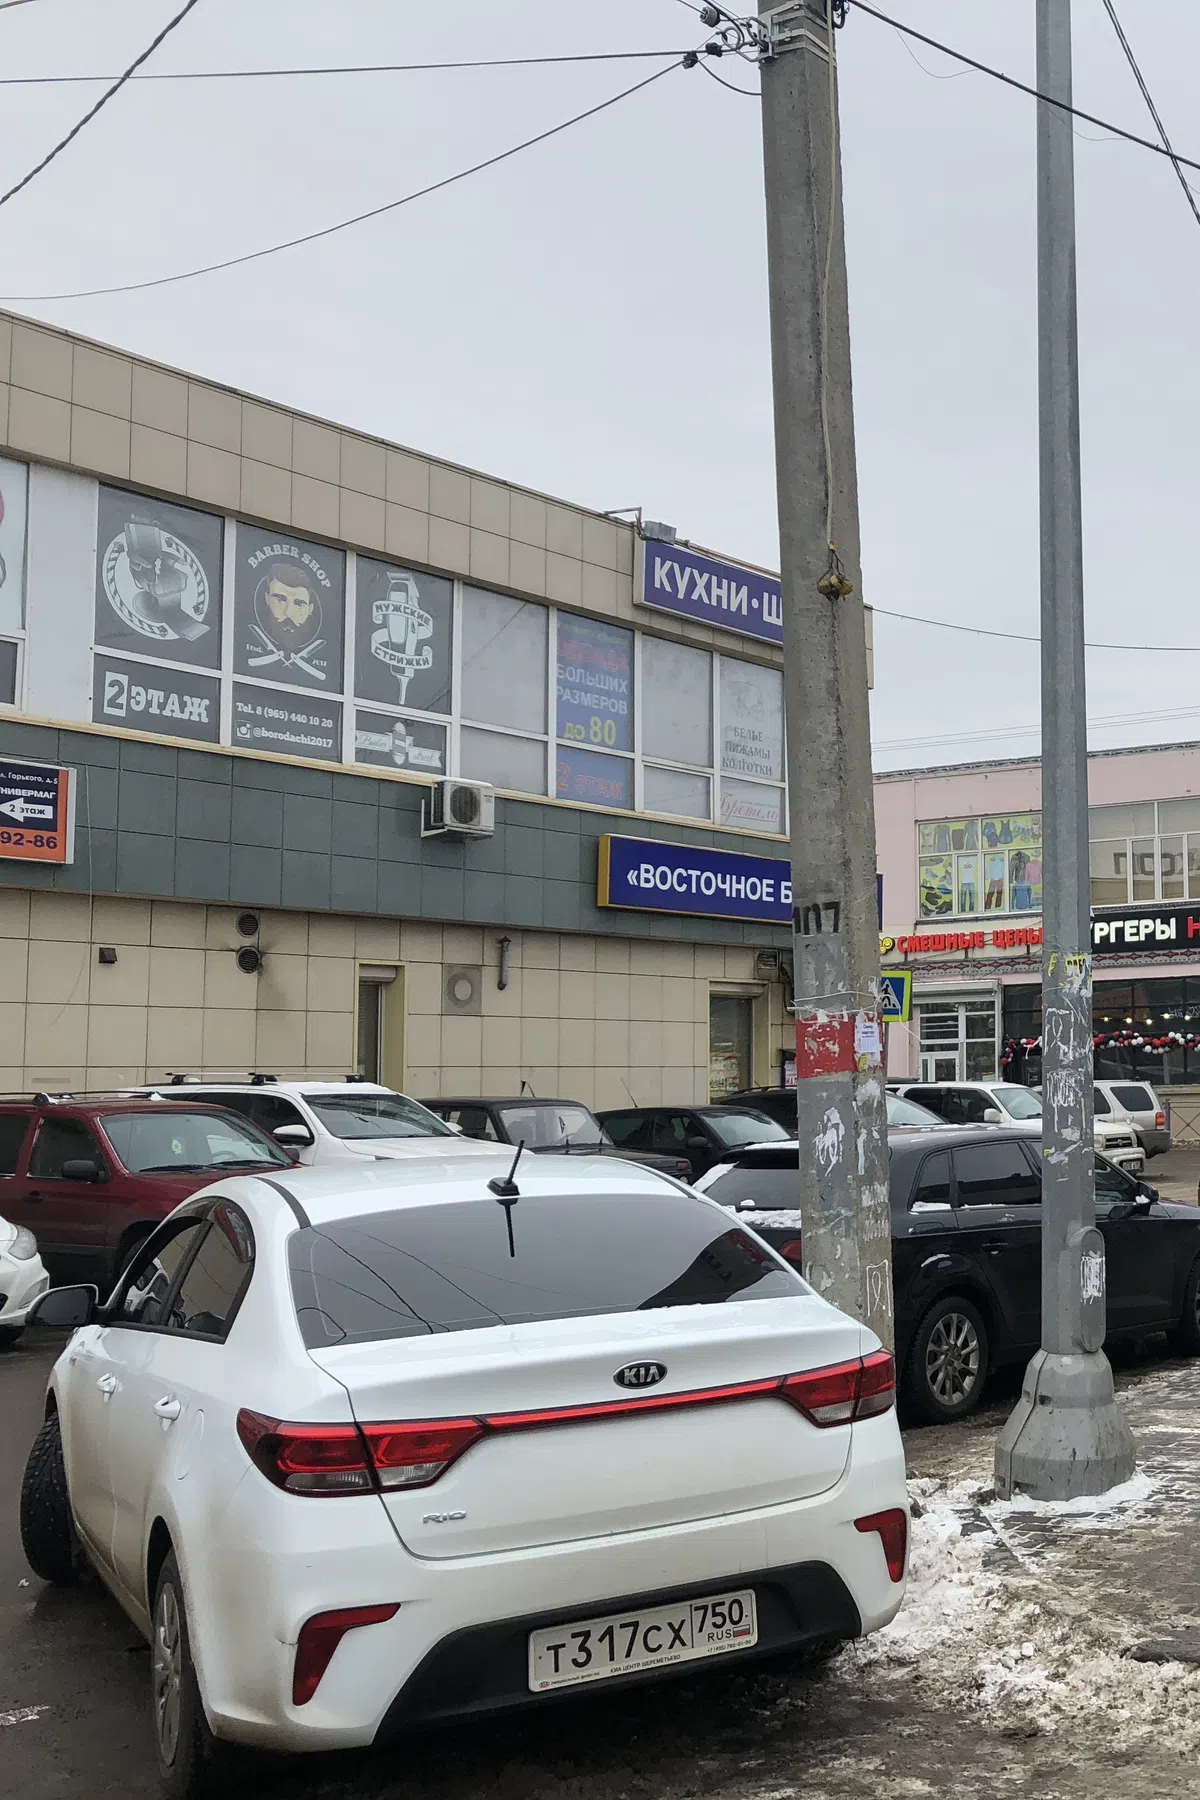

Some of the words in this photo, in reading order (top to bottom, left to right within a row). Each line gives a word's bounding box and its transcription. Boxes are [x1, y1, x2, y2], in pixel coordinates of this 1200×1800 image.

[247, 544, 299, 569] BARBER
[301, 553, 331, 588] SHOP
[653, 556, 749, 616] КУХНИ
[375, 603, 432, 626] МУЖСКИЕ
[374, 646, 430, 667] СТРИЖКИ
[556, 663, 629, 695] БОЛЬШИХ
[106, 678, 125, 709] 2
[130, 684, 210, 724] ЭТАЖ
[556, 686, 629, 716] РАЗМЕРОВ
[236, 702, 254, 715] Tel.
[256, 706, 262, 715] 8
[264, 706, 288, 722] (965)
[309, 715, 320, 725] 10
[321, 717, 333, 729] 20
[252, 727, 334, 749] @borodachi2017
[589, 715, 617, 747] 80
[733, 726, 764, 743] БЕЛЬЕ
[725, 740, 771, 761] ПИЖАМЫ
[722, 756, 773, 777] КОЛГОТКИ
[556, 763, 570, 791] 2
[575, 773, 625, 800] ЭТАЖ
[9, 804, 16, 813] 2
[20, 806, 46, 816] этаж
[627, 863, 775, 903] «ВОСТОЧНОЕ
[897, 931, 985, 953] СМЕШНЫЕ
[992, 927, 1043, 950] ЦЕНЫ
[1090, 917, 1176, 944] РГЕРЫ
[623, 1365, 660, 1384] KIA
[423, 1510, 467, 1524] RIO
[546, 1618, 687, 1673] Т317СХ
[693, 1598, 744, 1634] 750
[707, 1628, 732, 1643] RUS
[622, 1662, 641, 1672] ЦЕНТР
[641, 1654, 681, 1667] ШЕРЕМЕТЬЕВО
